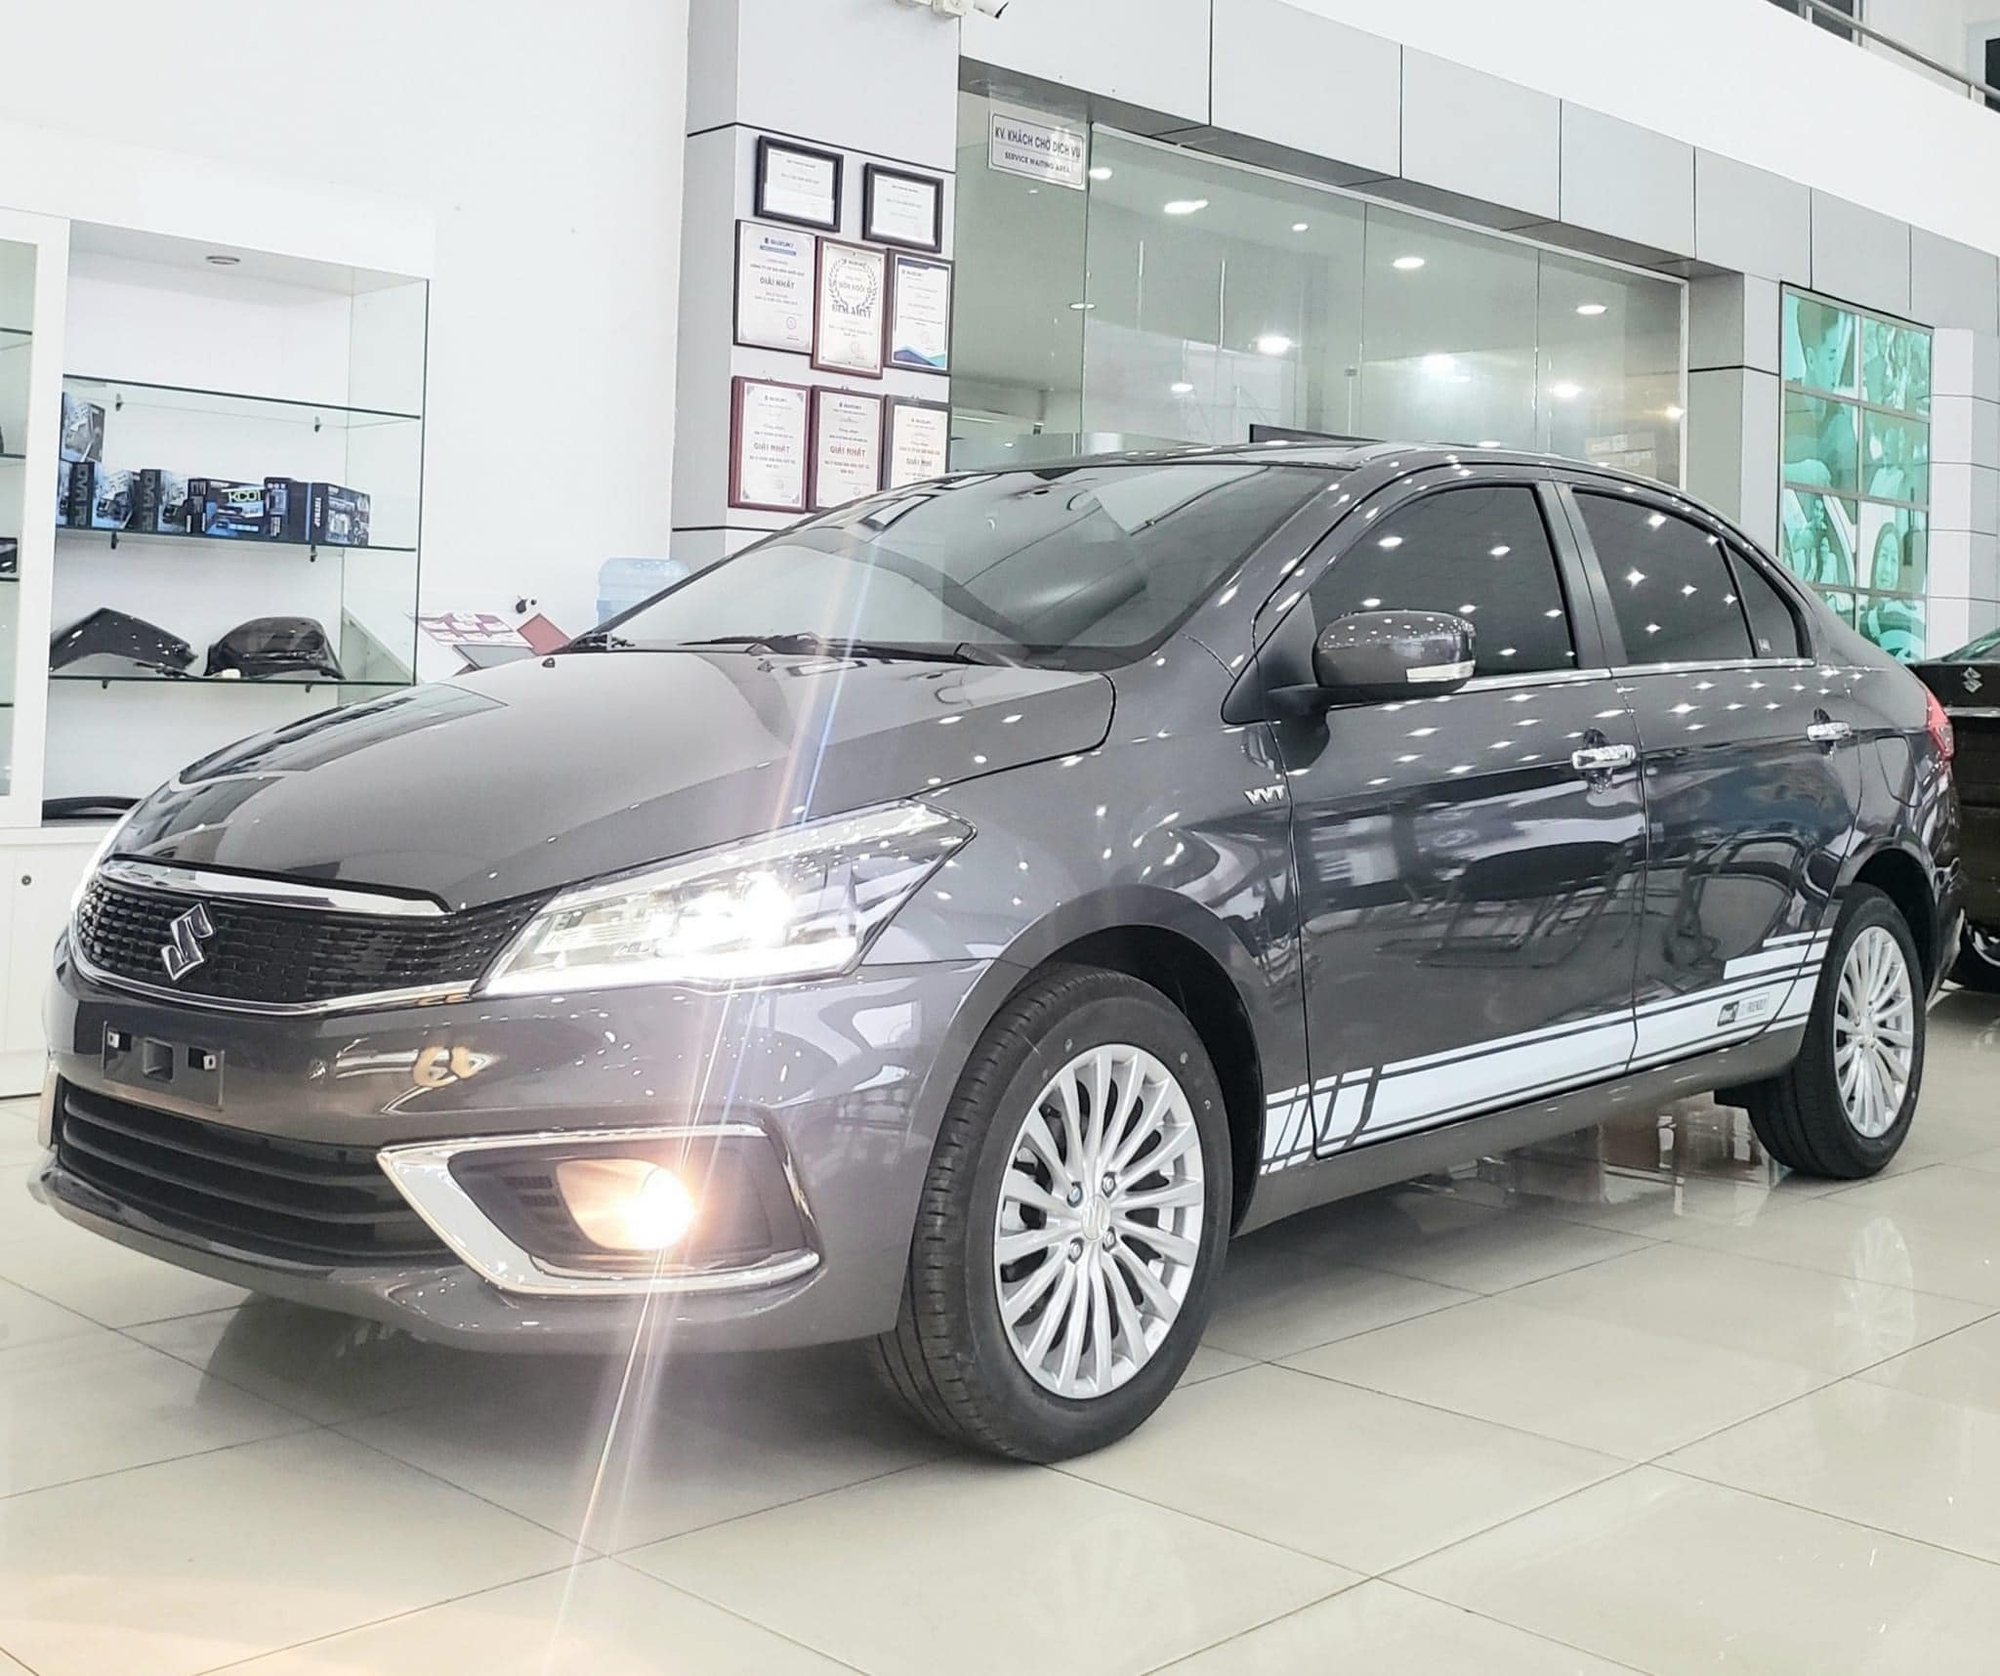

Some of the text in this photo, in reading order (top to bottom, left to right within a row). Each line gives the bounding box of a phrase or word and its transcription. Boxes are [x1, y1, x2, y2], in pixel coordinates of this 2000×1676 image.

[1007, 128, 1033, 146] KHÁCH
[1004, 151, 1029, 165] SERVICE
[1029, 157, 1054, 170] WAITING
[228, 489, 261, 504] KC01
[1243, 784, 1285, 806] VVT
